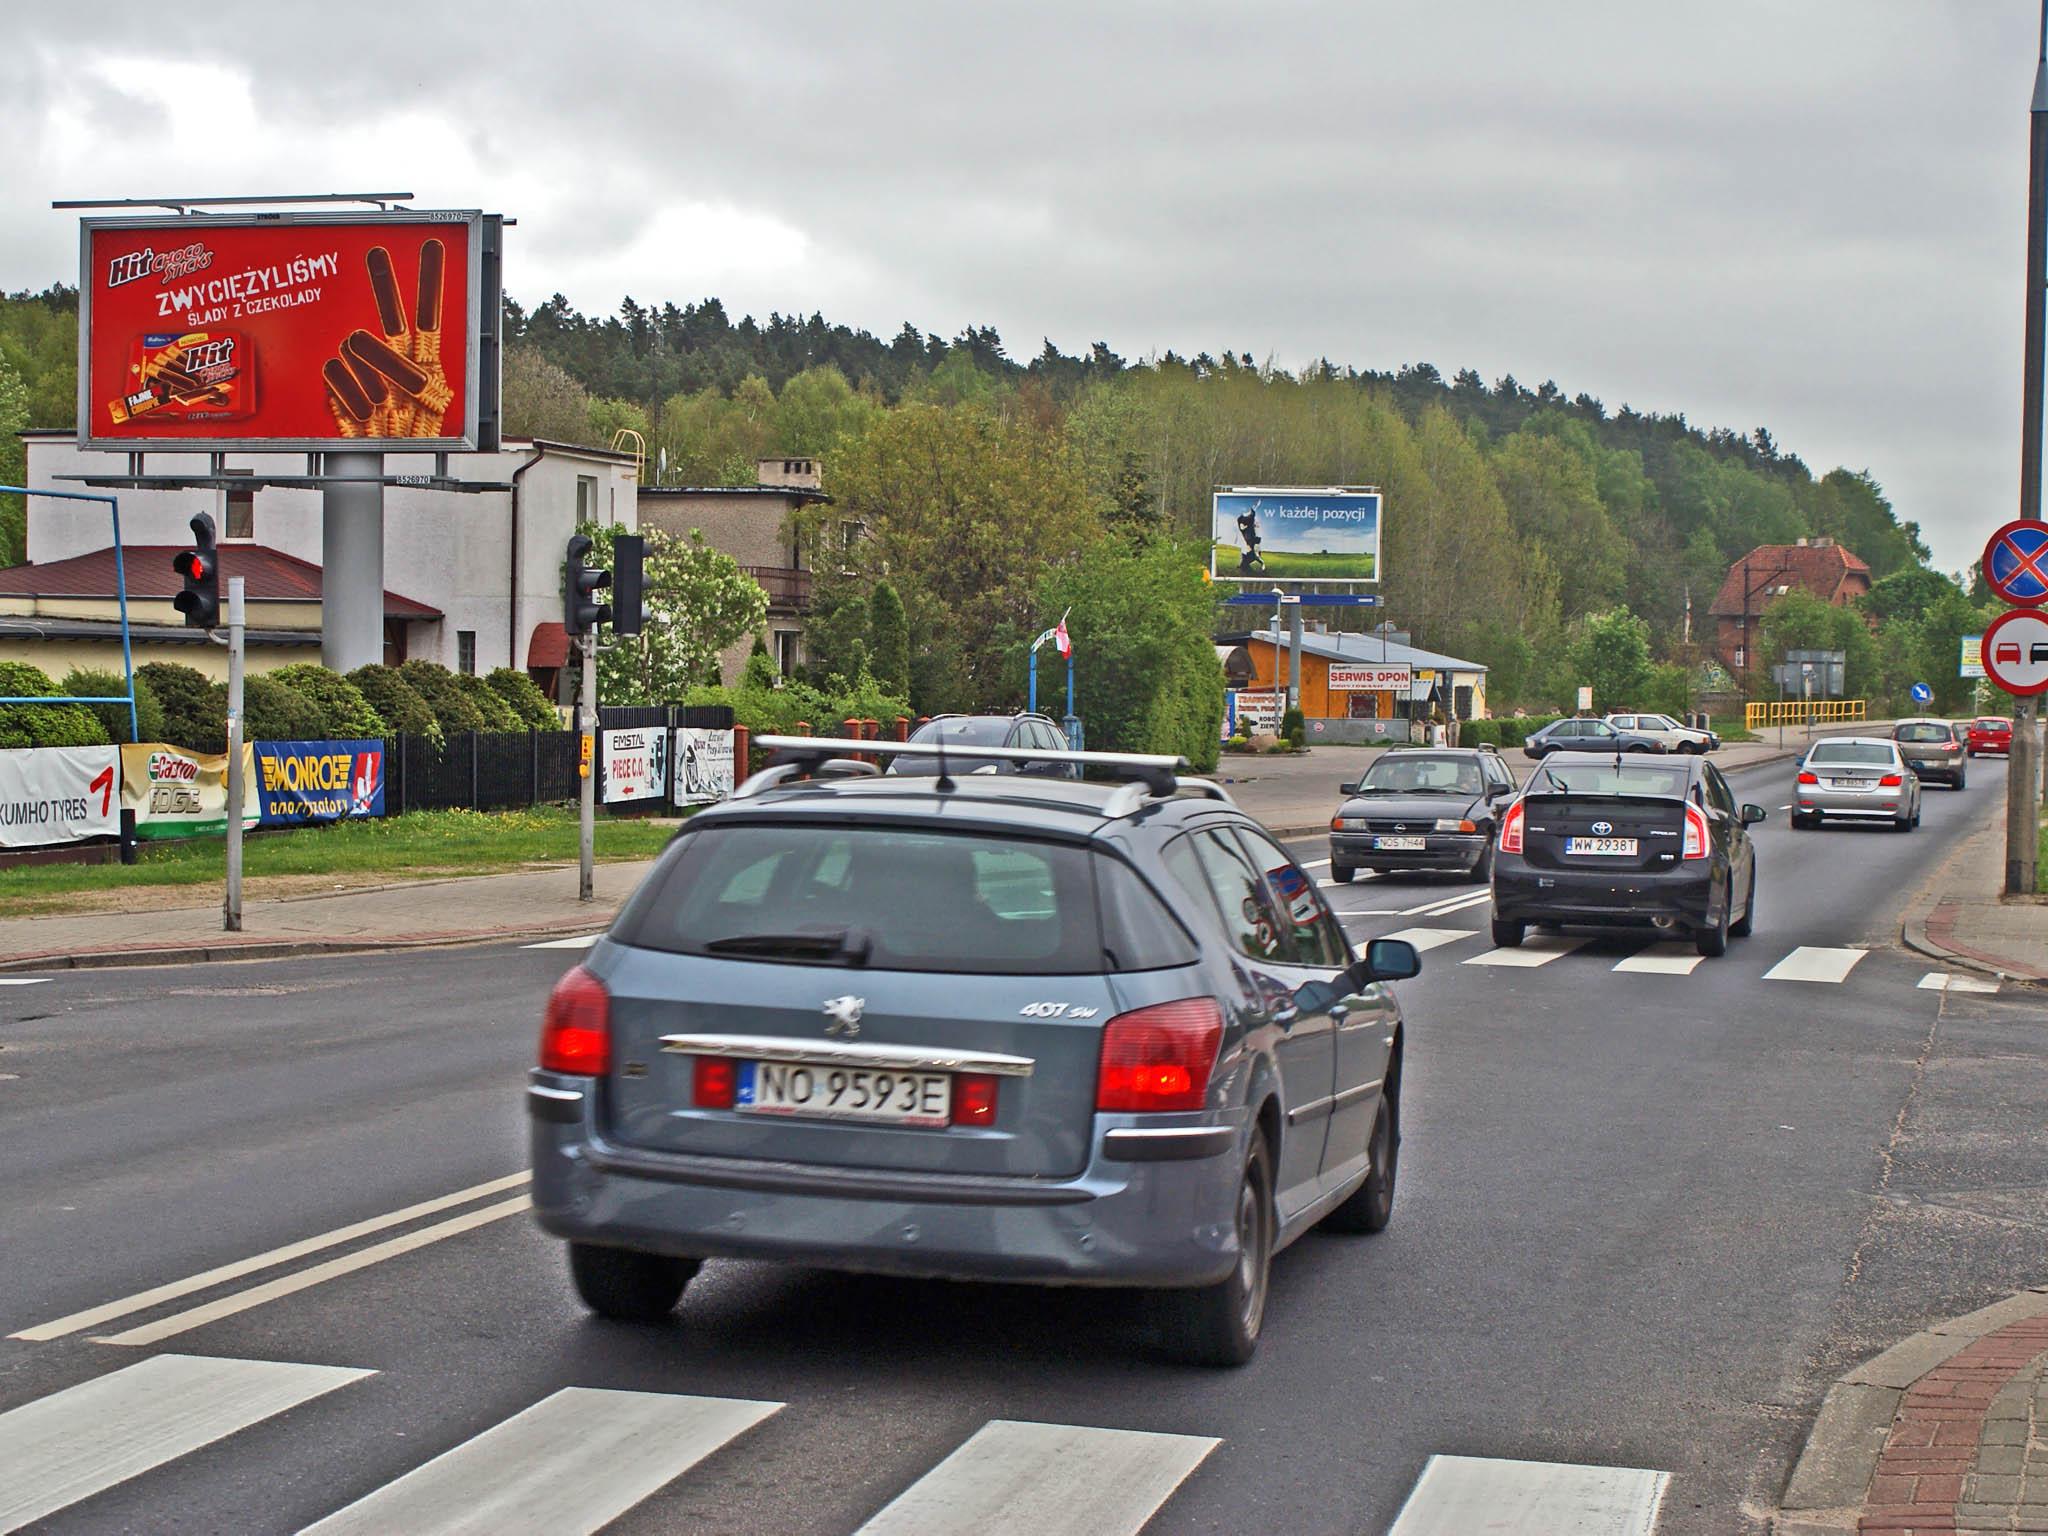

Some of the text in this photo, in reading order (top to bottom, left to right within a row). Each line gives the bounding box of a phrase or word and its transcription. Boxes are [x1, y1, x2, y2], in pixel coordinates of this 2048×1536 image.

[430, 213, 462, 221] 8526970
[109, 242, 204, 287] Hit CHOCO
[162, 252, 214, 284] STICKS
[155, 252, 338, 317] ZWYCIĘŻYLIŚMY
[187, 288, 322, 326] ŚLADY Z CZEKOLADY
[186, 338, 234, 373] Hit
[397, 476, 430, 484] 8526970
[1264, 506, 1366, 521] w każdej pozycji
[1331, 672, 1409, 682] SERWIS OPON
[613, 734, 645, 750] EMSTAL
[158, 756, 197, 780] Castrol
[268, 755, 348, 791] MONROE
[613, 757, 645, 779] PIECE C.O.
[51, 798, 87, 822] TYRES
[1574, 839, 1635, 851] WW 2938T
[1019, 1002, 1070, 1018] 407
[761, 1066, 944, 1114] NO 9593E
